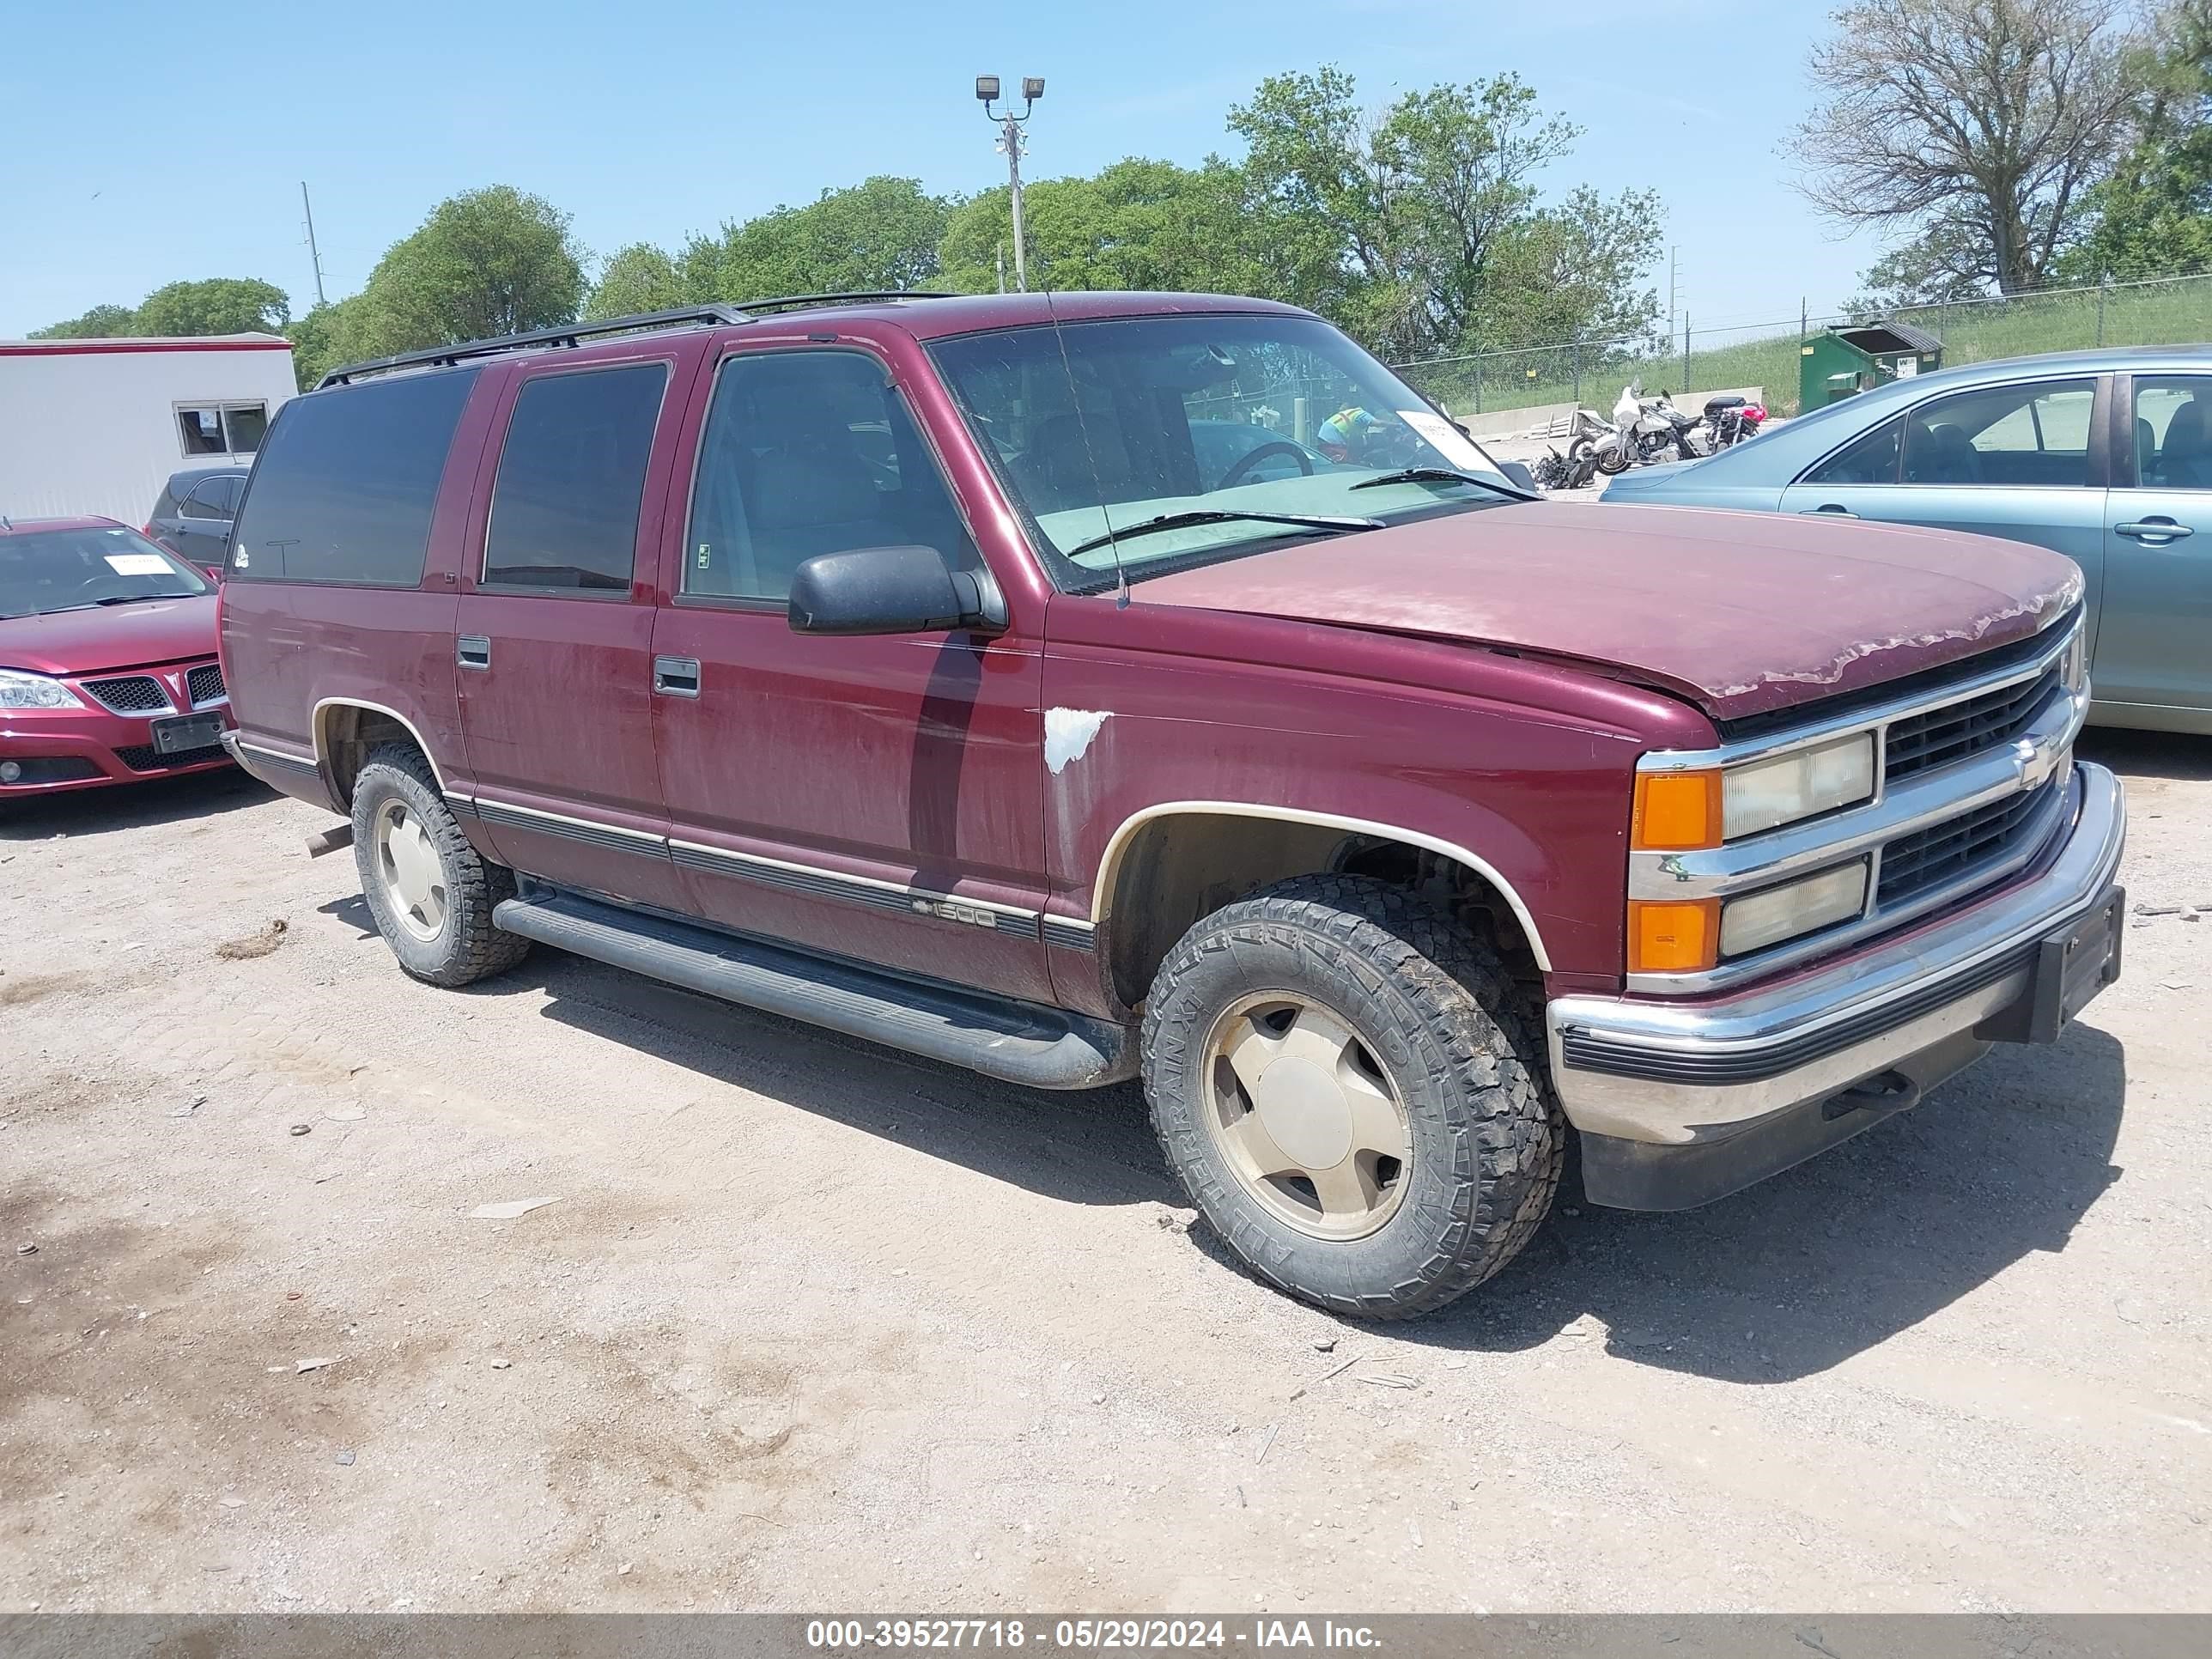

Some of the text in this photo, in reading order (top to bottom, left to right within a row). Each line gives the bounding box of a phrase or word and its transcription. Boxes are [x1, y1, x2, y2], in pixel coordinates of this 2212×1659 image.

[933, 902, 996, 927] 1500
[1171, 986, 1204, 1034] XT
[1164, 1036, 1225, 1213] TERRAIN
[1233, 1207, 1294, 1267] ALL
